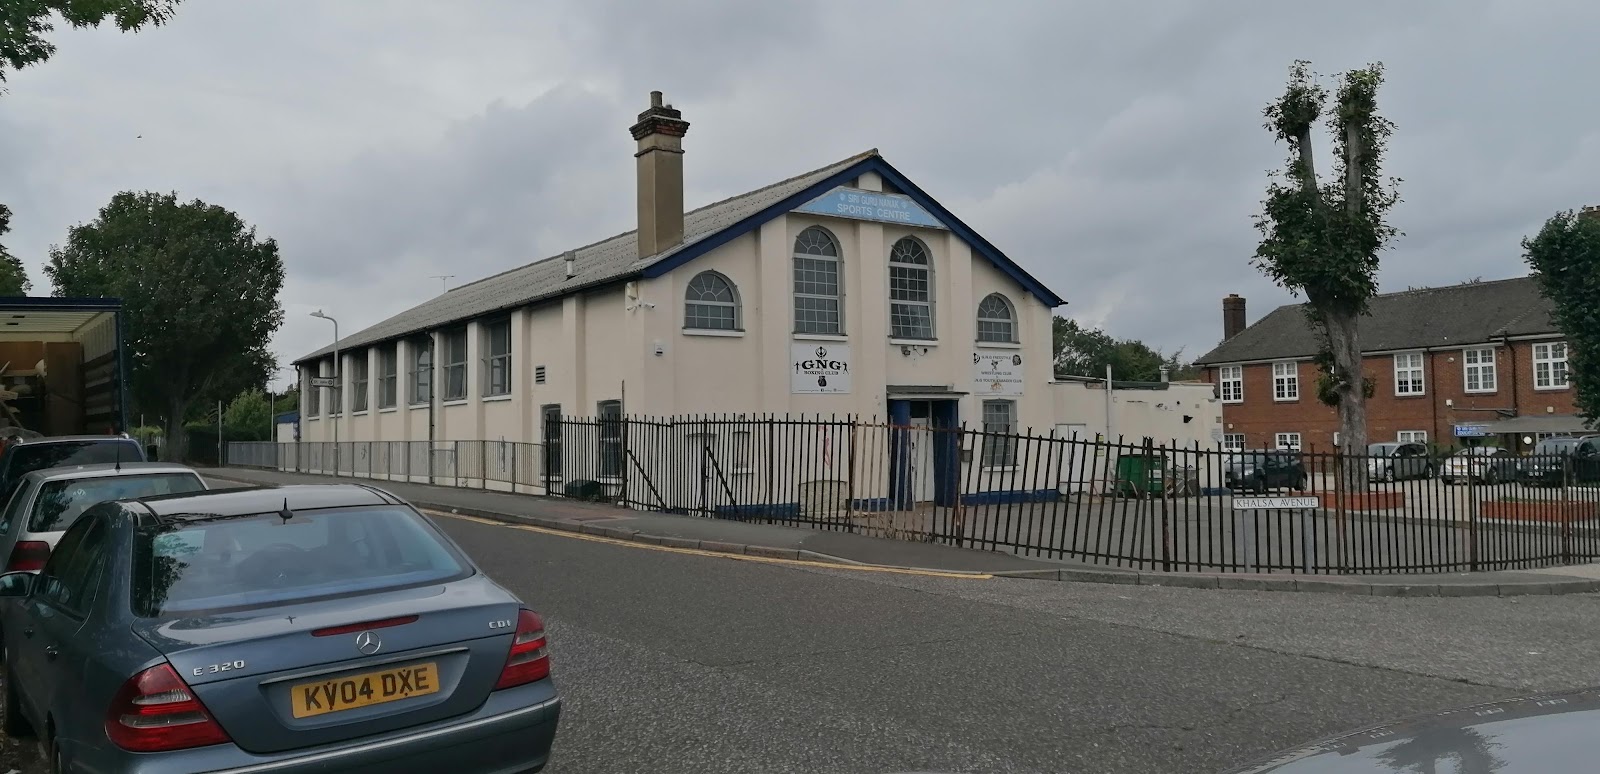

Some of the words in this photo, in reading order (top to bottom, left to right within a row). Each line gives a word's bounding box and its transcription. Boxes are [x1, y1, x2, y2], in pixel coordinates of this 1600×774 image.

[848, 193, 860, 203] SIRI
[861, 195, 878, 207] GURU
[879, 197, 900, 209] NANAK
[837, 203, 873, 216] SPORTS
[876, 208, 911, 221] CENTRE
[801, 359, 841, 371] GNG
[1236, 499, 1275, 508] KHALSA
[1279, 498, 1316, 507] AVENUE
[488, 619, 511, 629] CDI
[193, 667, 203, 676] E
[209, 659, 246, 674] 320
[304, 677, 374, 711] KV04
[380, 667, 430, 698] DXE
